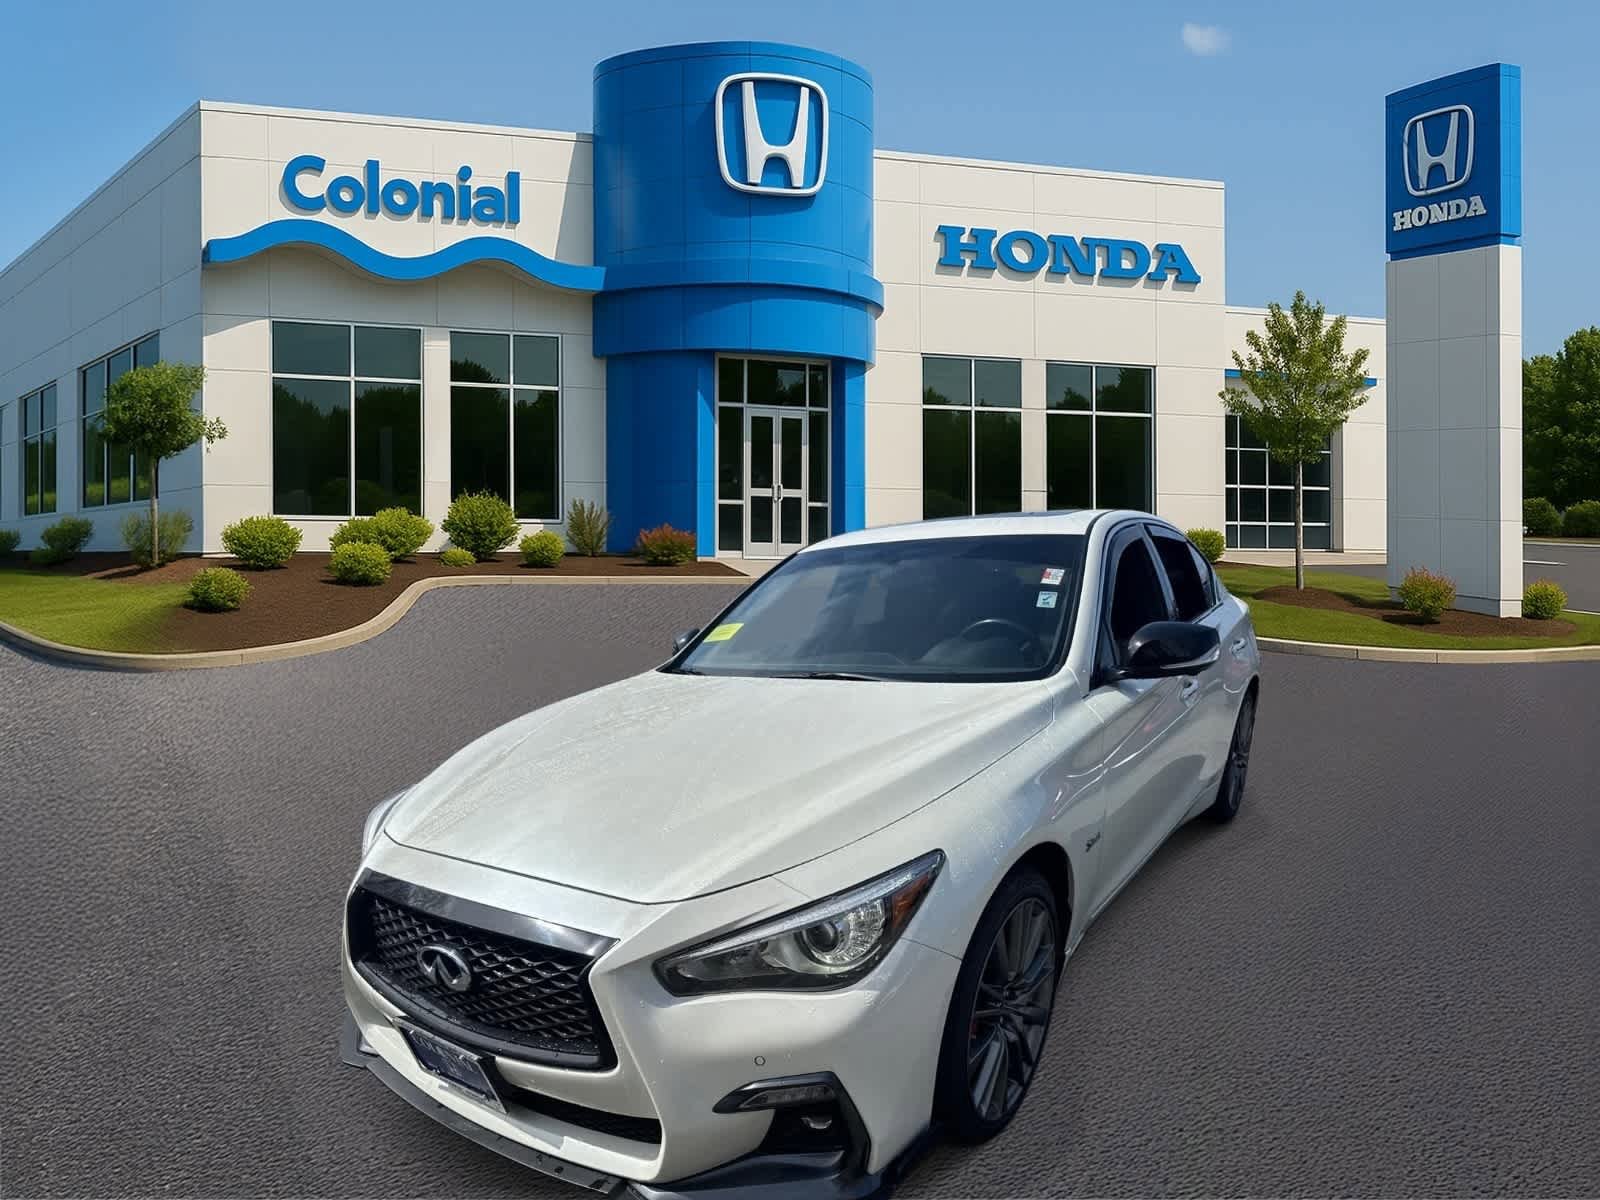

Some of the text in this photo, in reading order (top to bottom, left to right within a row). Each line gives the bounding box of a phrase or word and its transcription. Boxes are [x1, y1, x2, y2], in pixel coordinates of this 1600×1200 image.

[281, 154, 521, 225] Colonial
[1392, 195, 1487, 232] HONDA
[936, 224, 1202, 284] HONDA
